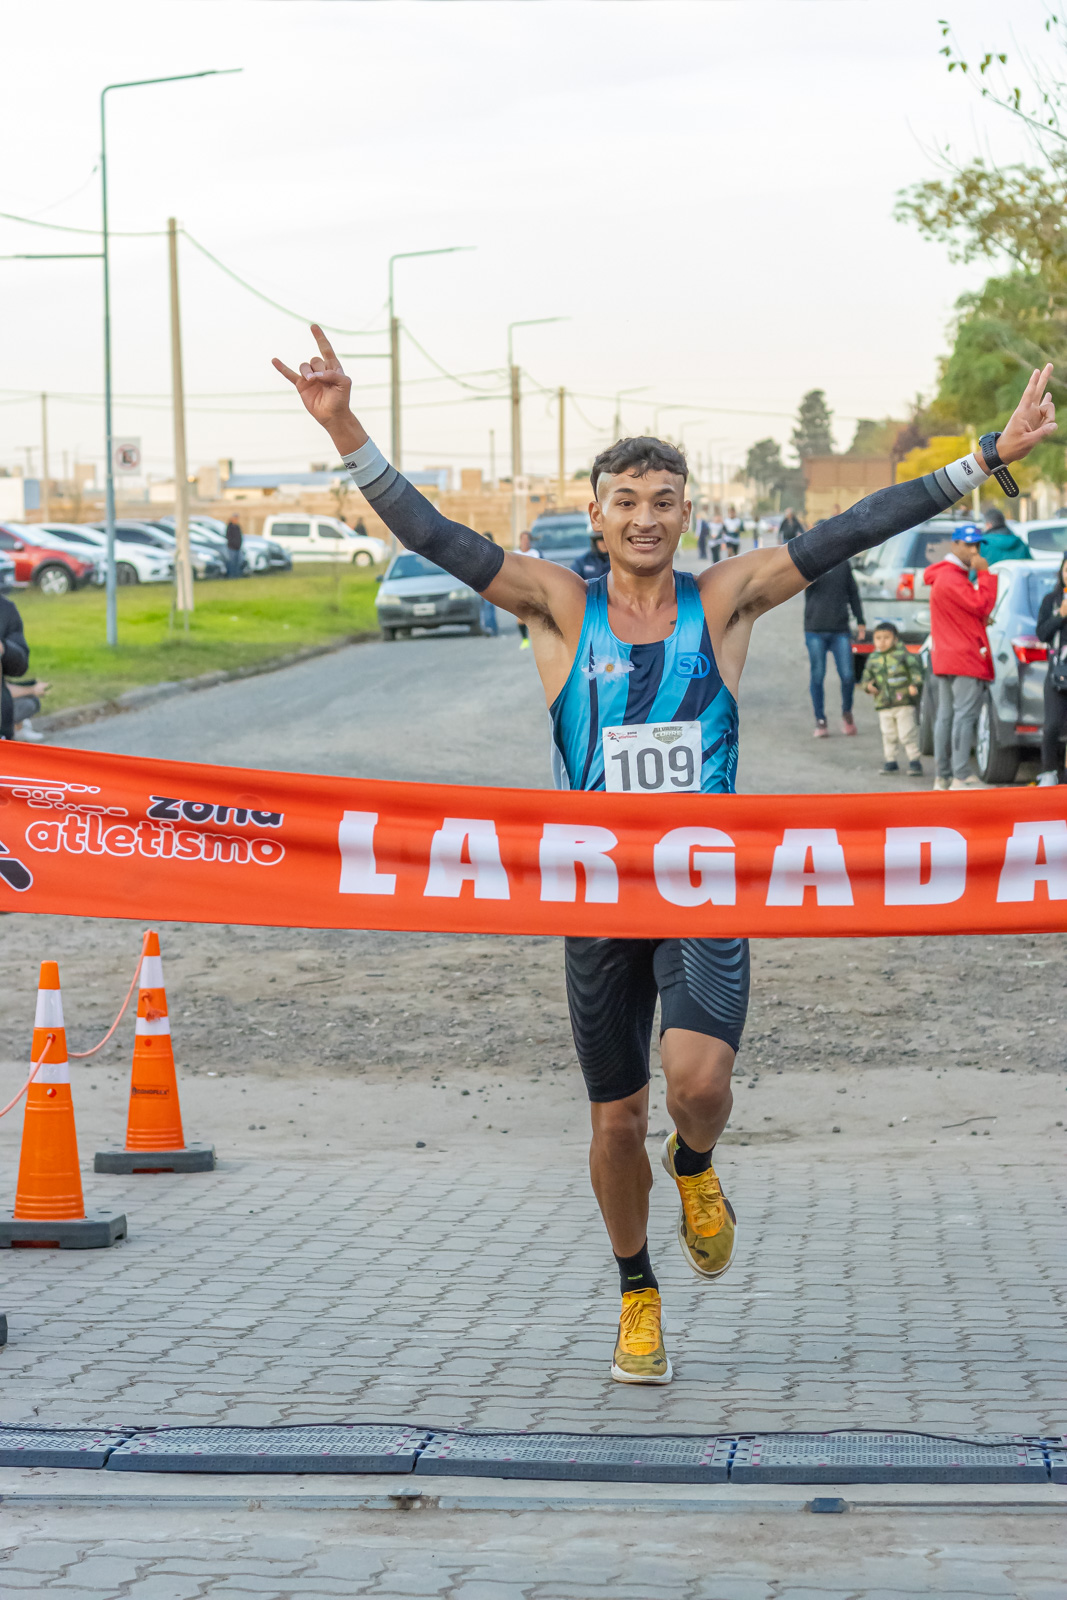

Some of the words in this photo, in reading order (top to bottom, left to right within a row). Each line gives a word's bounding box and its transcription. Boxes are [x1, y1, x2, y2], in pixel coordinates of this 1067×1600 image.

[611, 745, 695, 791] 109
[147, 795, 284, 828] zona
[25, 813, 286, 866] atletismo
[338, 810, 1067, 908] LARGADA
